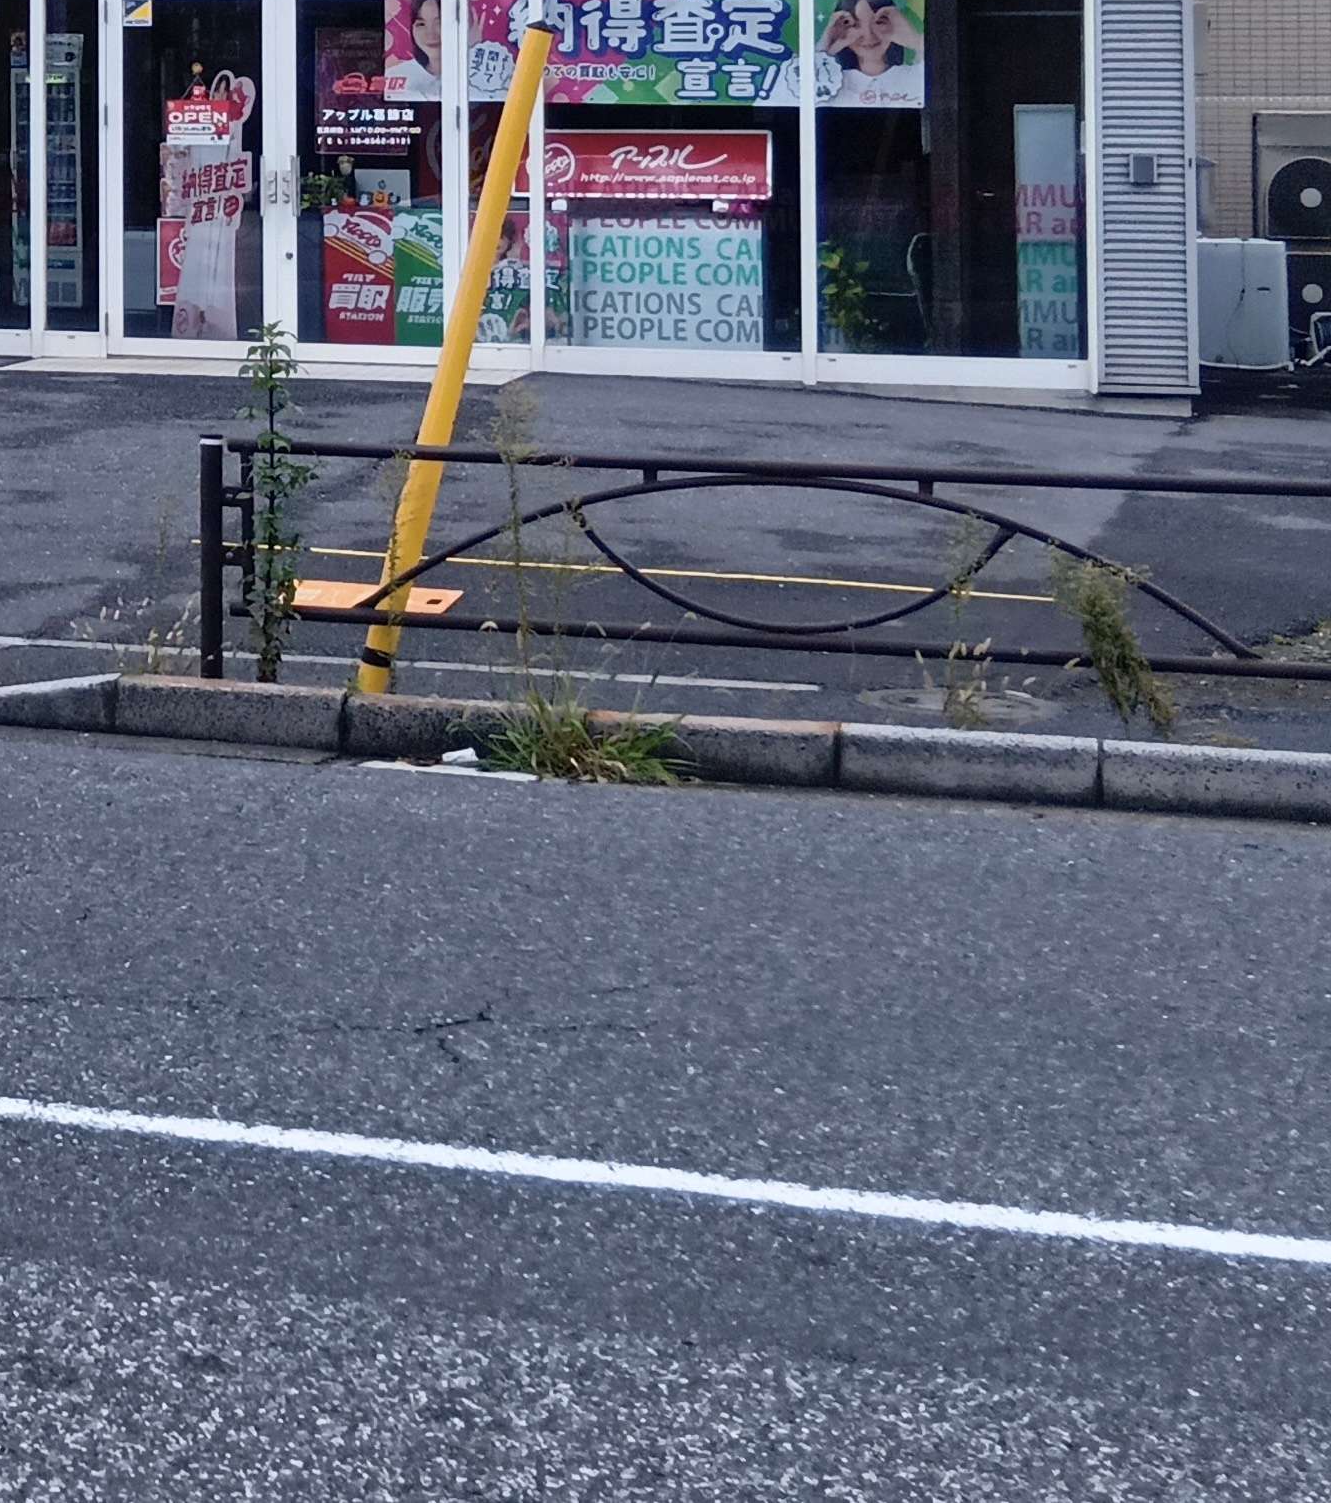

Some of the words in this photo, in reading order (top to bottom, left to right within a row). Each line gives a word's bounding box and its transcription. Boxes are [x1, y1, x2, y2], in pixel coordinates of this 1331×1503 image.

[676, 57, 779, 98] 宣言!
[168, 111, 228, 124] OPEN
[582, 261, 688, 285] PEOPLE
[583, 316, 689, 341] PEOPLE
